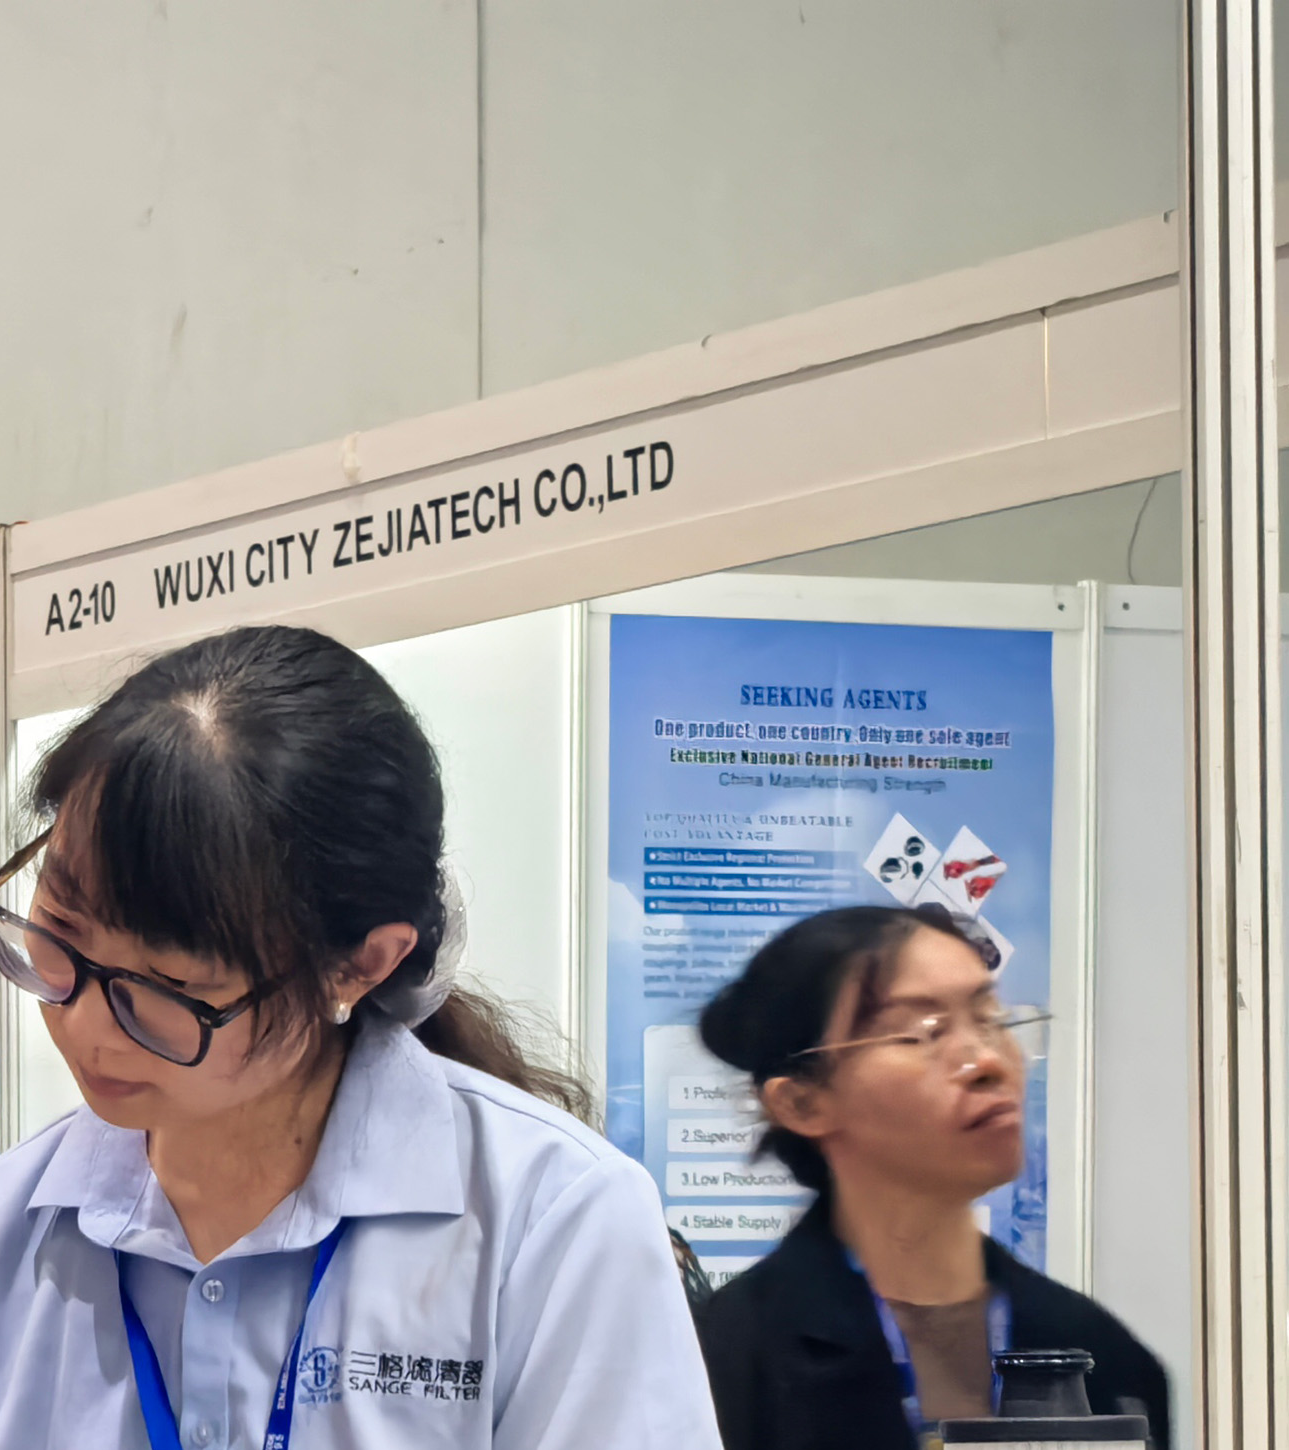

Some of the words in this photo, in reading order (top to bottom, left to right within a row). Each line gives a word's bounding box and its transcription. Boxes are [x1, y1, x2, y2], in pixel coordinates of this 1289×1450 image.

[45, 580, 115, 635] A2-10
[154, 550, 234, 608] WUXI
[245, 528, 319, 588] CITY
[333, 478, 521, 568] ZEJIATECH
[533, 441, 674, 517] CO.,LTD
[740, 684, 833, 708] SEEKING
[843, 689, 927, 711] AGENTS
[655, 718, 684, 736] One
[759, 725, 786, 740] one
[859, 725, 891, 744] Only
[895, 729, 923, 743] one
[966, 730, 1010, 748] agent
[670, 748, 736, 764] Exclusive
[741, 750, 800, 765] National
[805, 751, 860, 767] General
[864, 752, 903, 769] Agent
[908, 754, 993, 770] Recruitment
[759, 815, 854, 827] UNBEATABLE
[738, 1215, 782, 1231] Supply
[348, 1376, 413, 1396] SANGE
[424, 1383, 482, 1401] FILTER
